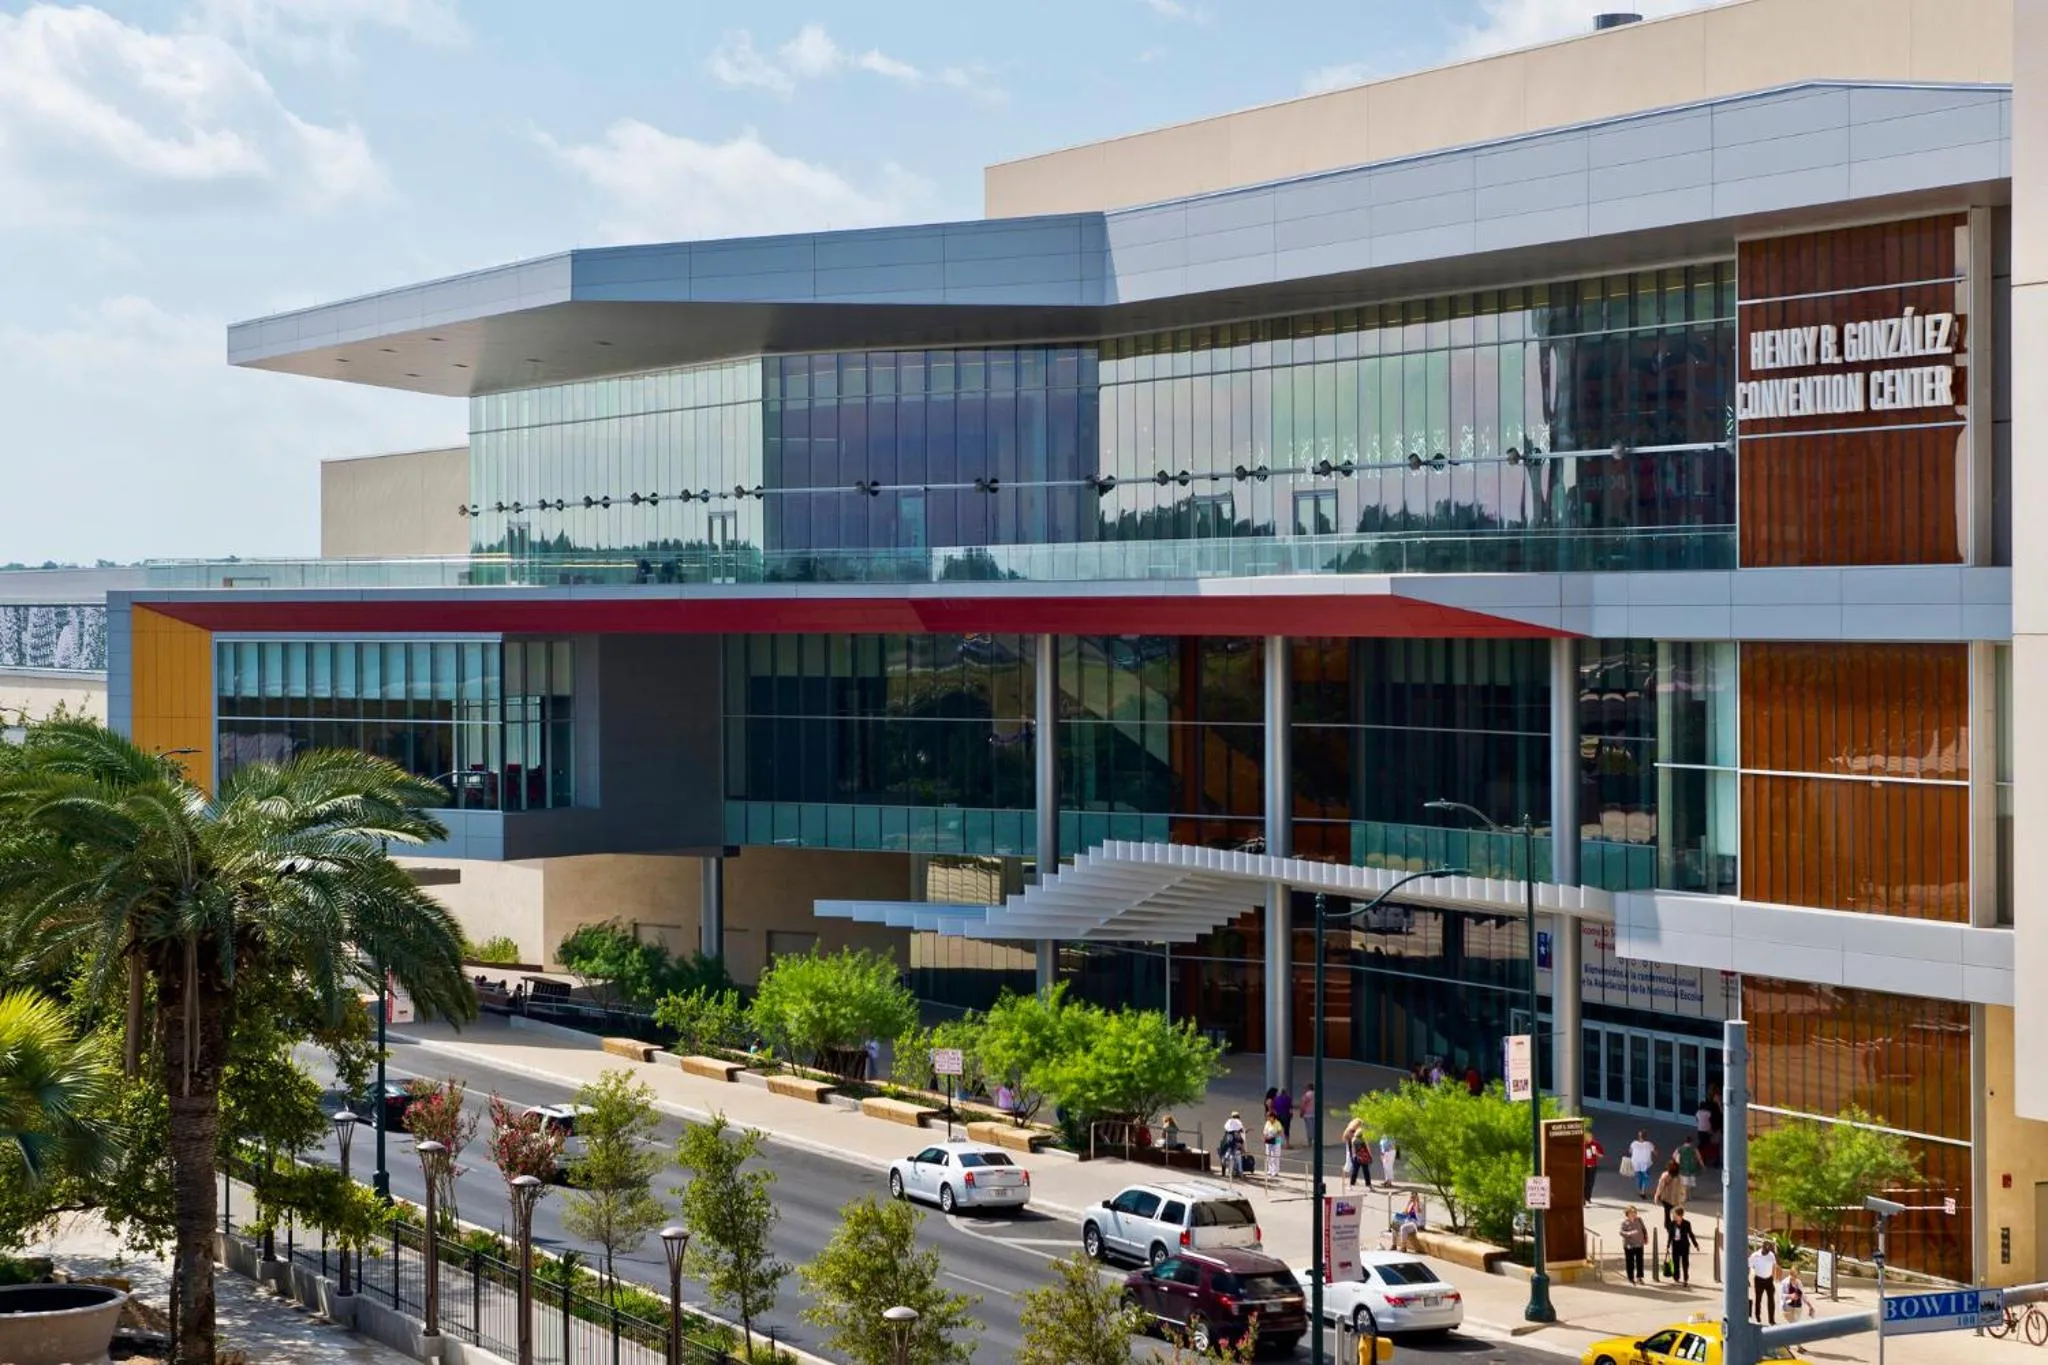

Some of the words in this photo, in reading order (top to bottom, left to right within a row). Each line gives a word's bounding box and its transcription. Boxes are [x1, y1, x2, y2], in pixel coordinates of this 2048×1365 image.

[1750, 326, 1819, 370] HENRY
[1820, 324, 1843, 364] B.
[1844, 306, 1953, 362] GONZÁLEZ
[1738, 372, 1865, 420] CONVENTION
[1870, 365, 1953, 411] CENTER
[1884, 1293, 1975, 1319] BOWIE
